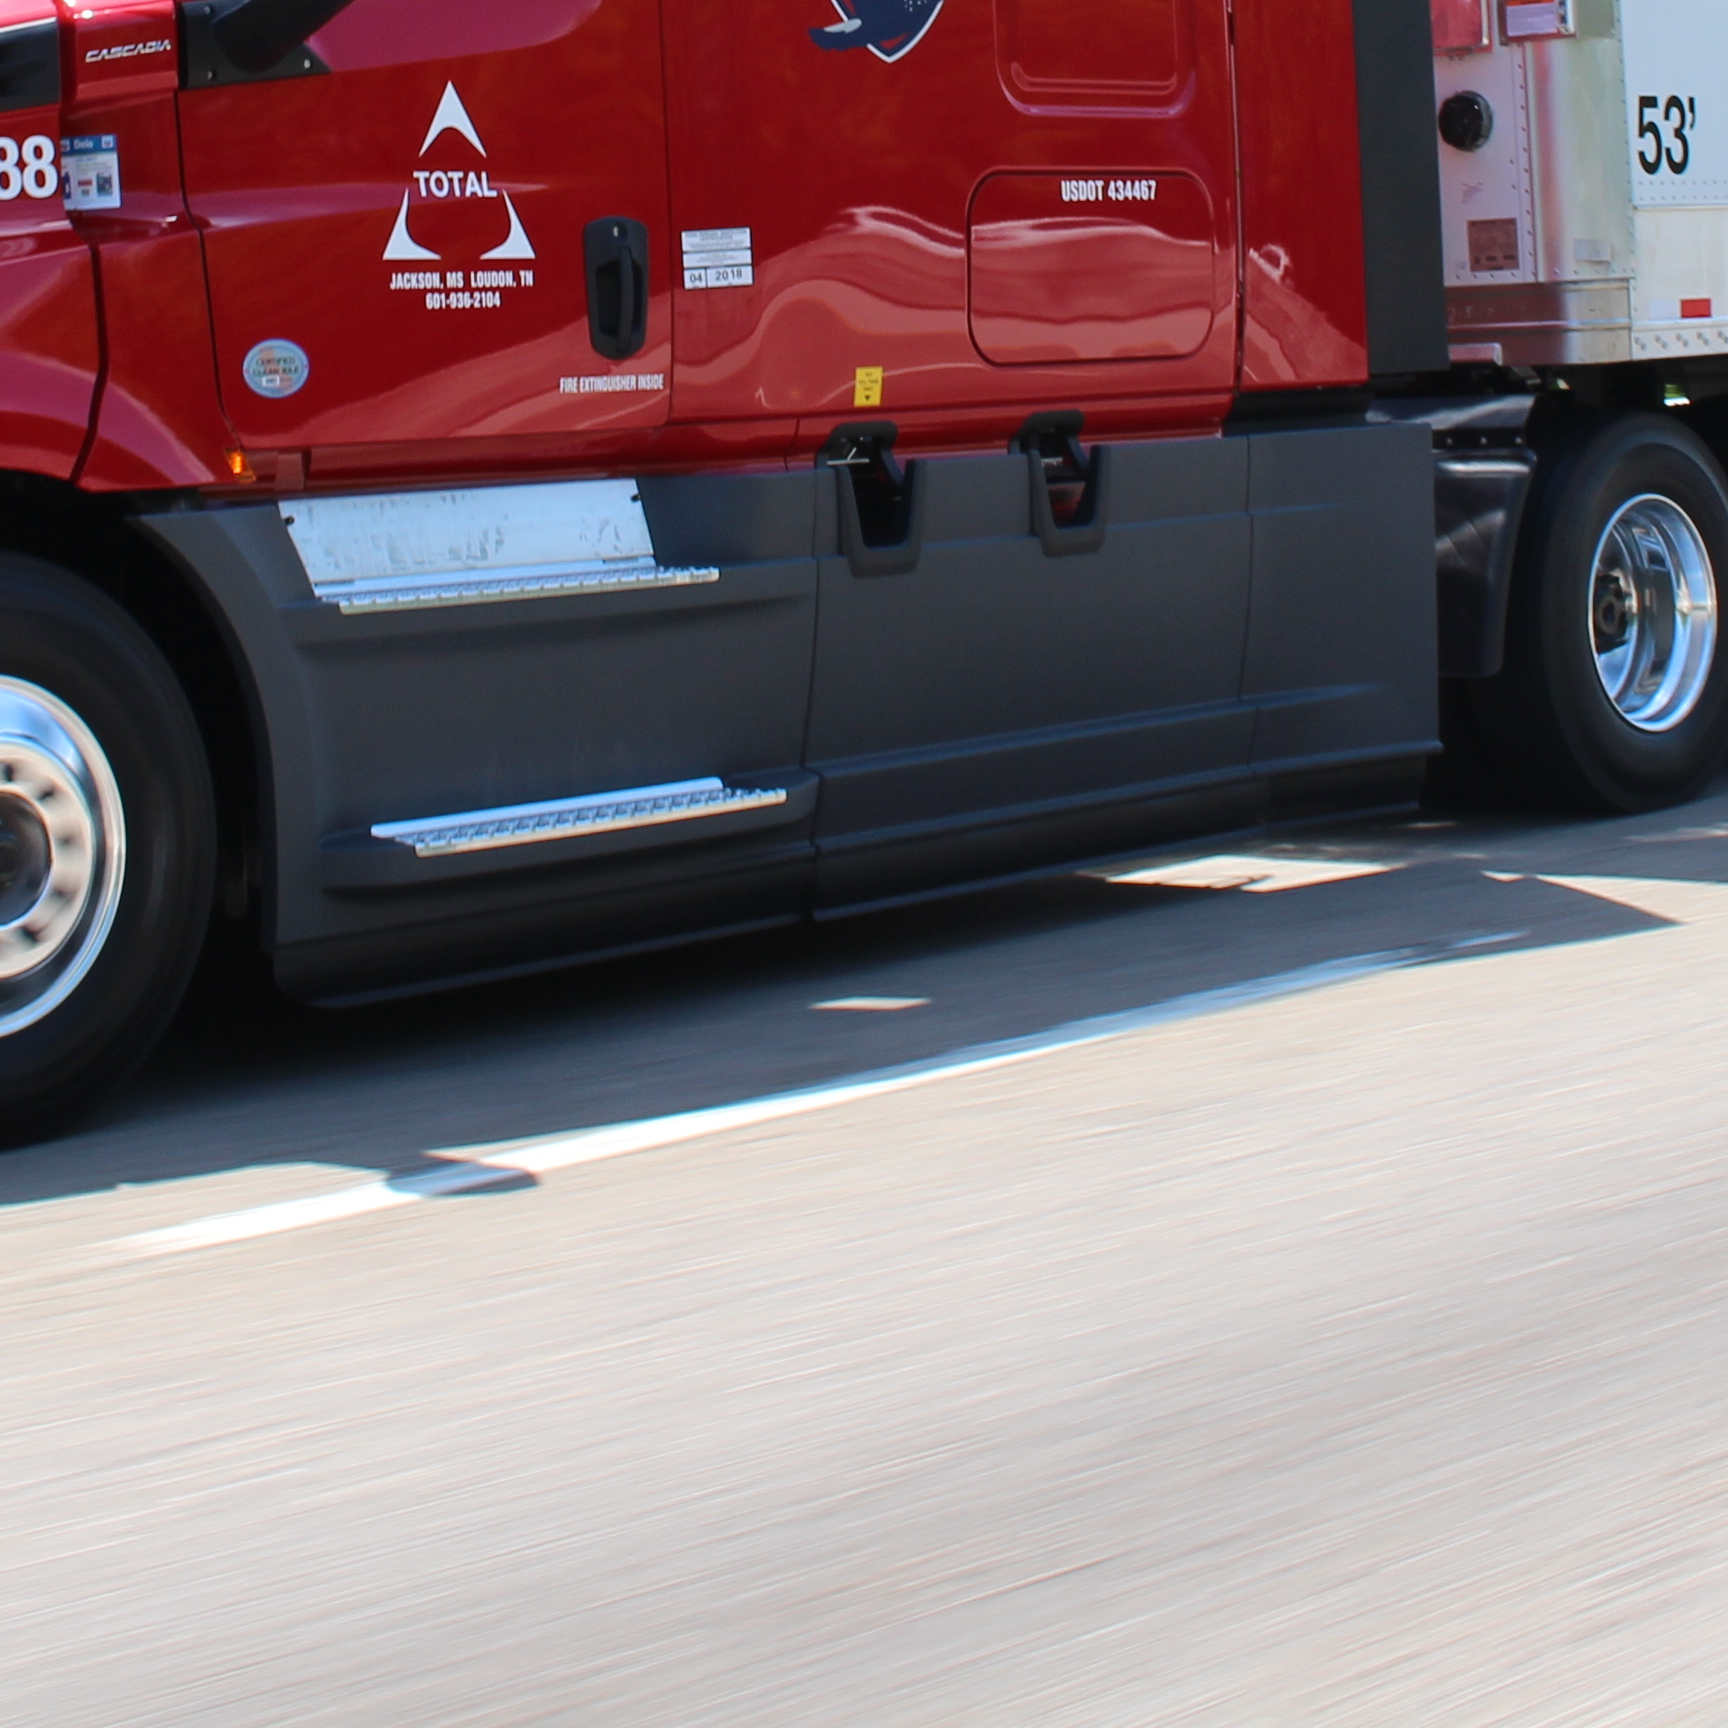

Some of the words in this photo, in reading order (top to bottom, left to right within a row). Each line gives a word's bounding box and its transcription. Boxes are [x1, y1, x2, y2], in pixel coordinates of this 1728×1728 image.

[85, 39, 172, 63] CASCADIA
[1637, 94, 1696, 175] 53'
[413, 171, 498, 198] TOTAL
[1060, 179, 1105, 202] USDOT
[1107, 179, 1157, 201] 434467
[446, 271, 465, 289] MS
[519, 269, 534, 287] TN
[425, 290, 501, 310] 601-936-2104
[558, 376, 579, 394] FIRE
[579, 374, 637, 393] EXTINGUISHER
[637, 372, 665, 391] INSIDE
